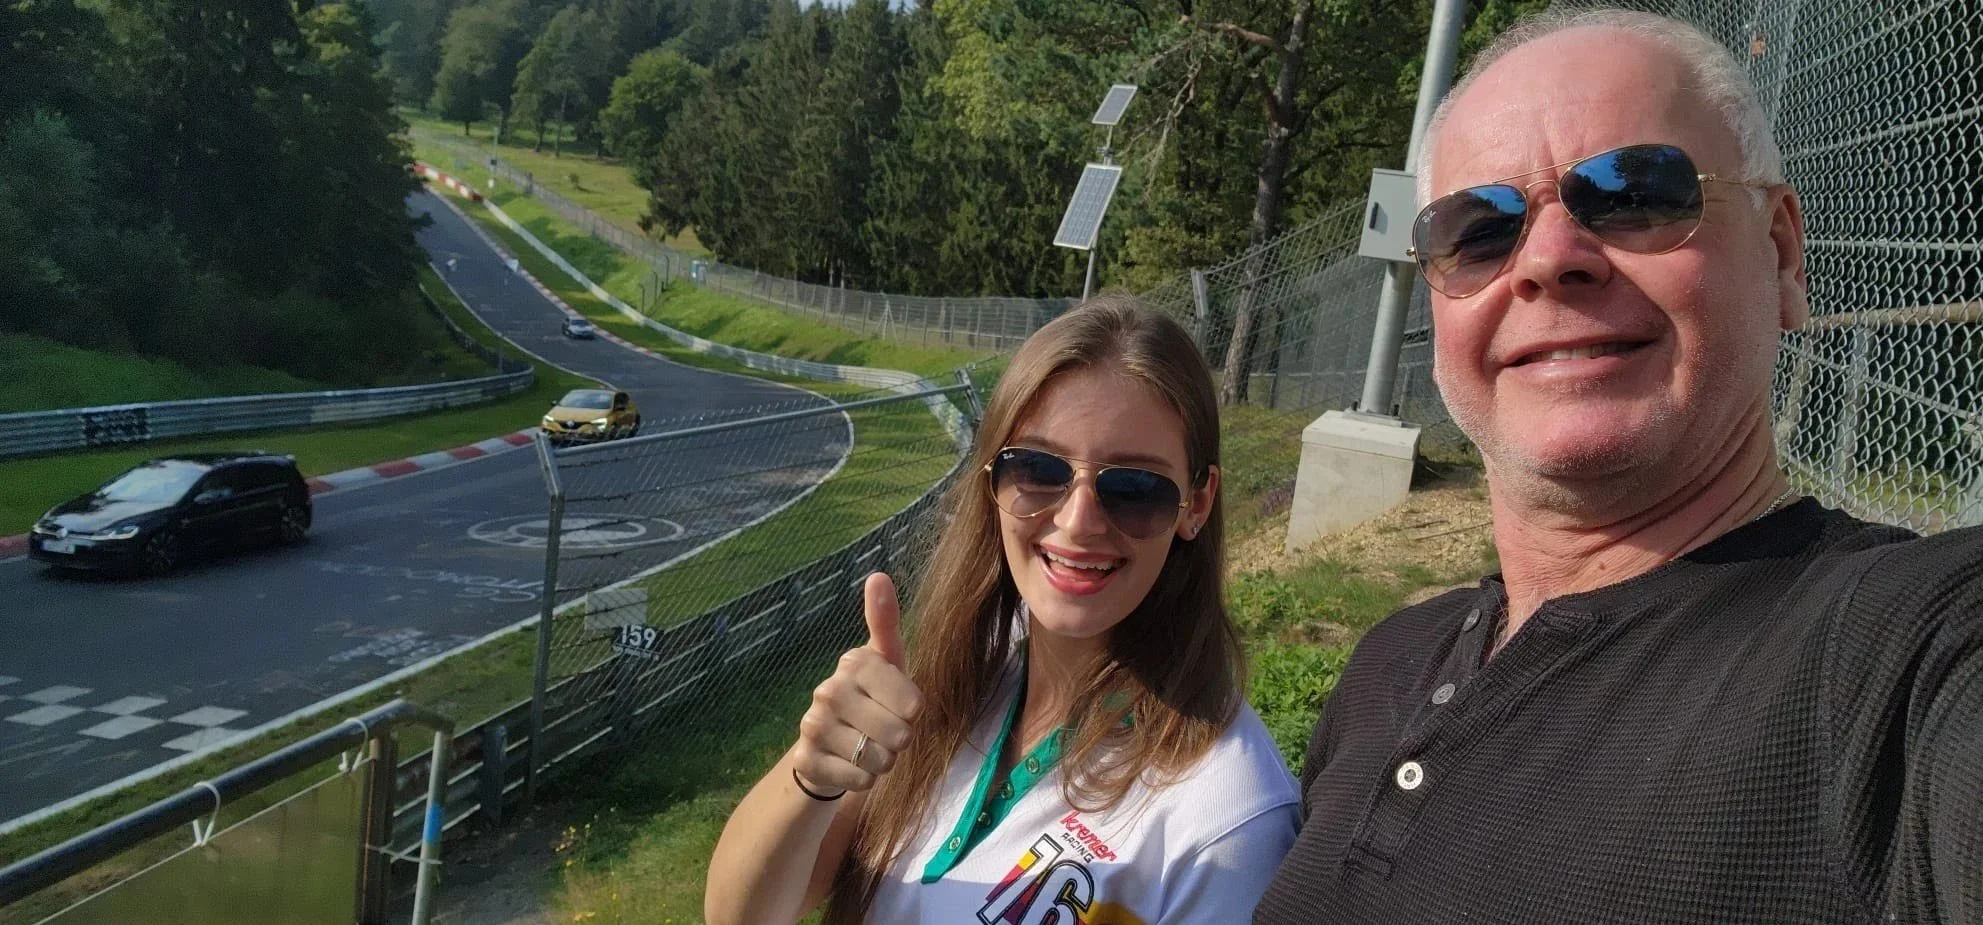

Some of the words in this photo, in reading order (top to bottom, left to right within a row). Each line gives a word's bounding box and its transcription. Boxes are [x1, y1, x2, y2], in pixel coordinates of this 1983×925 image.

[621, 624, 656, 649] 159
[1060, 810, 1117, 861] kremer
[1061, 832, 1095, 863] RACING
